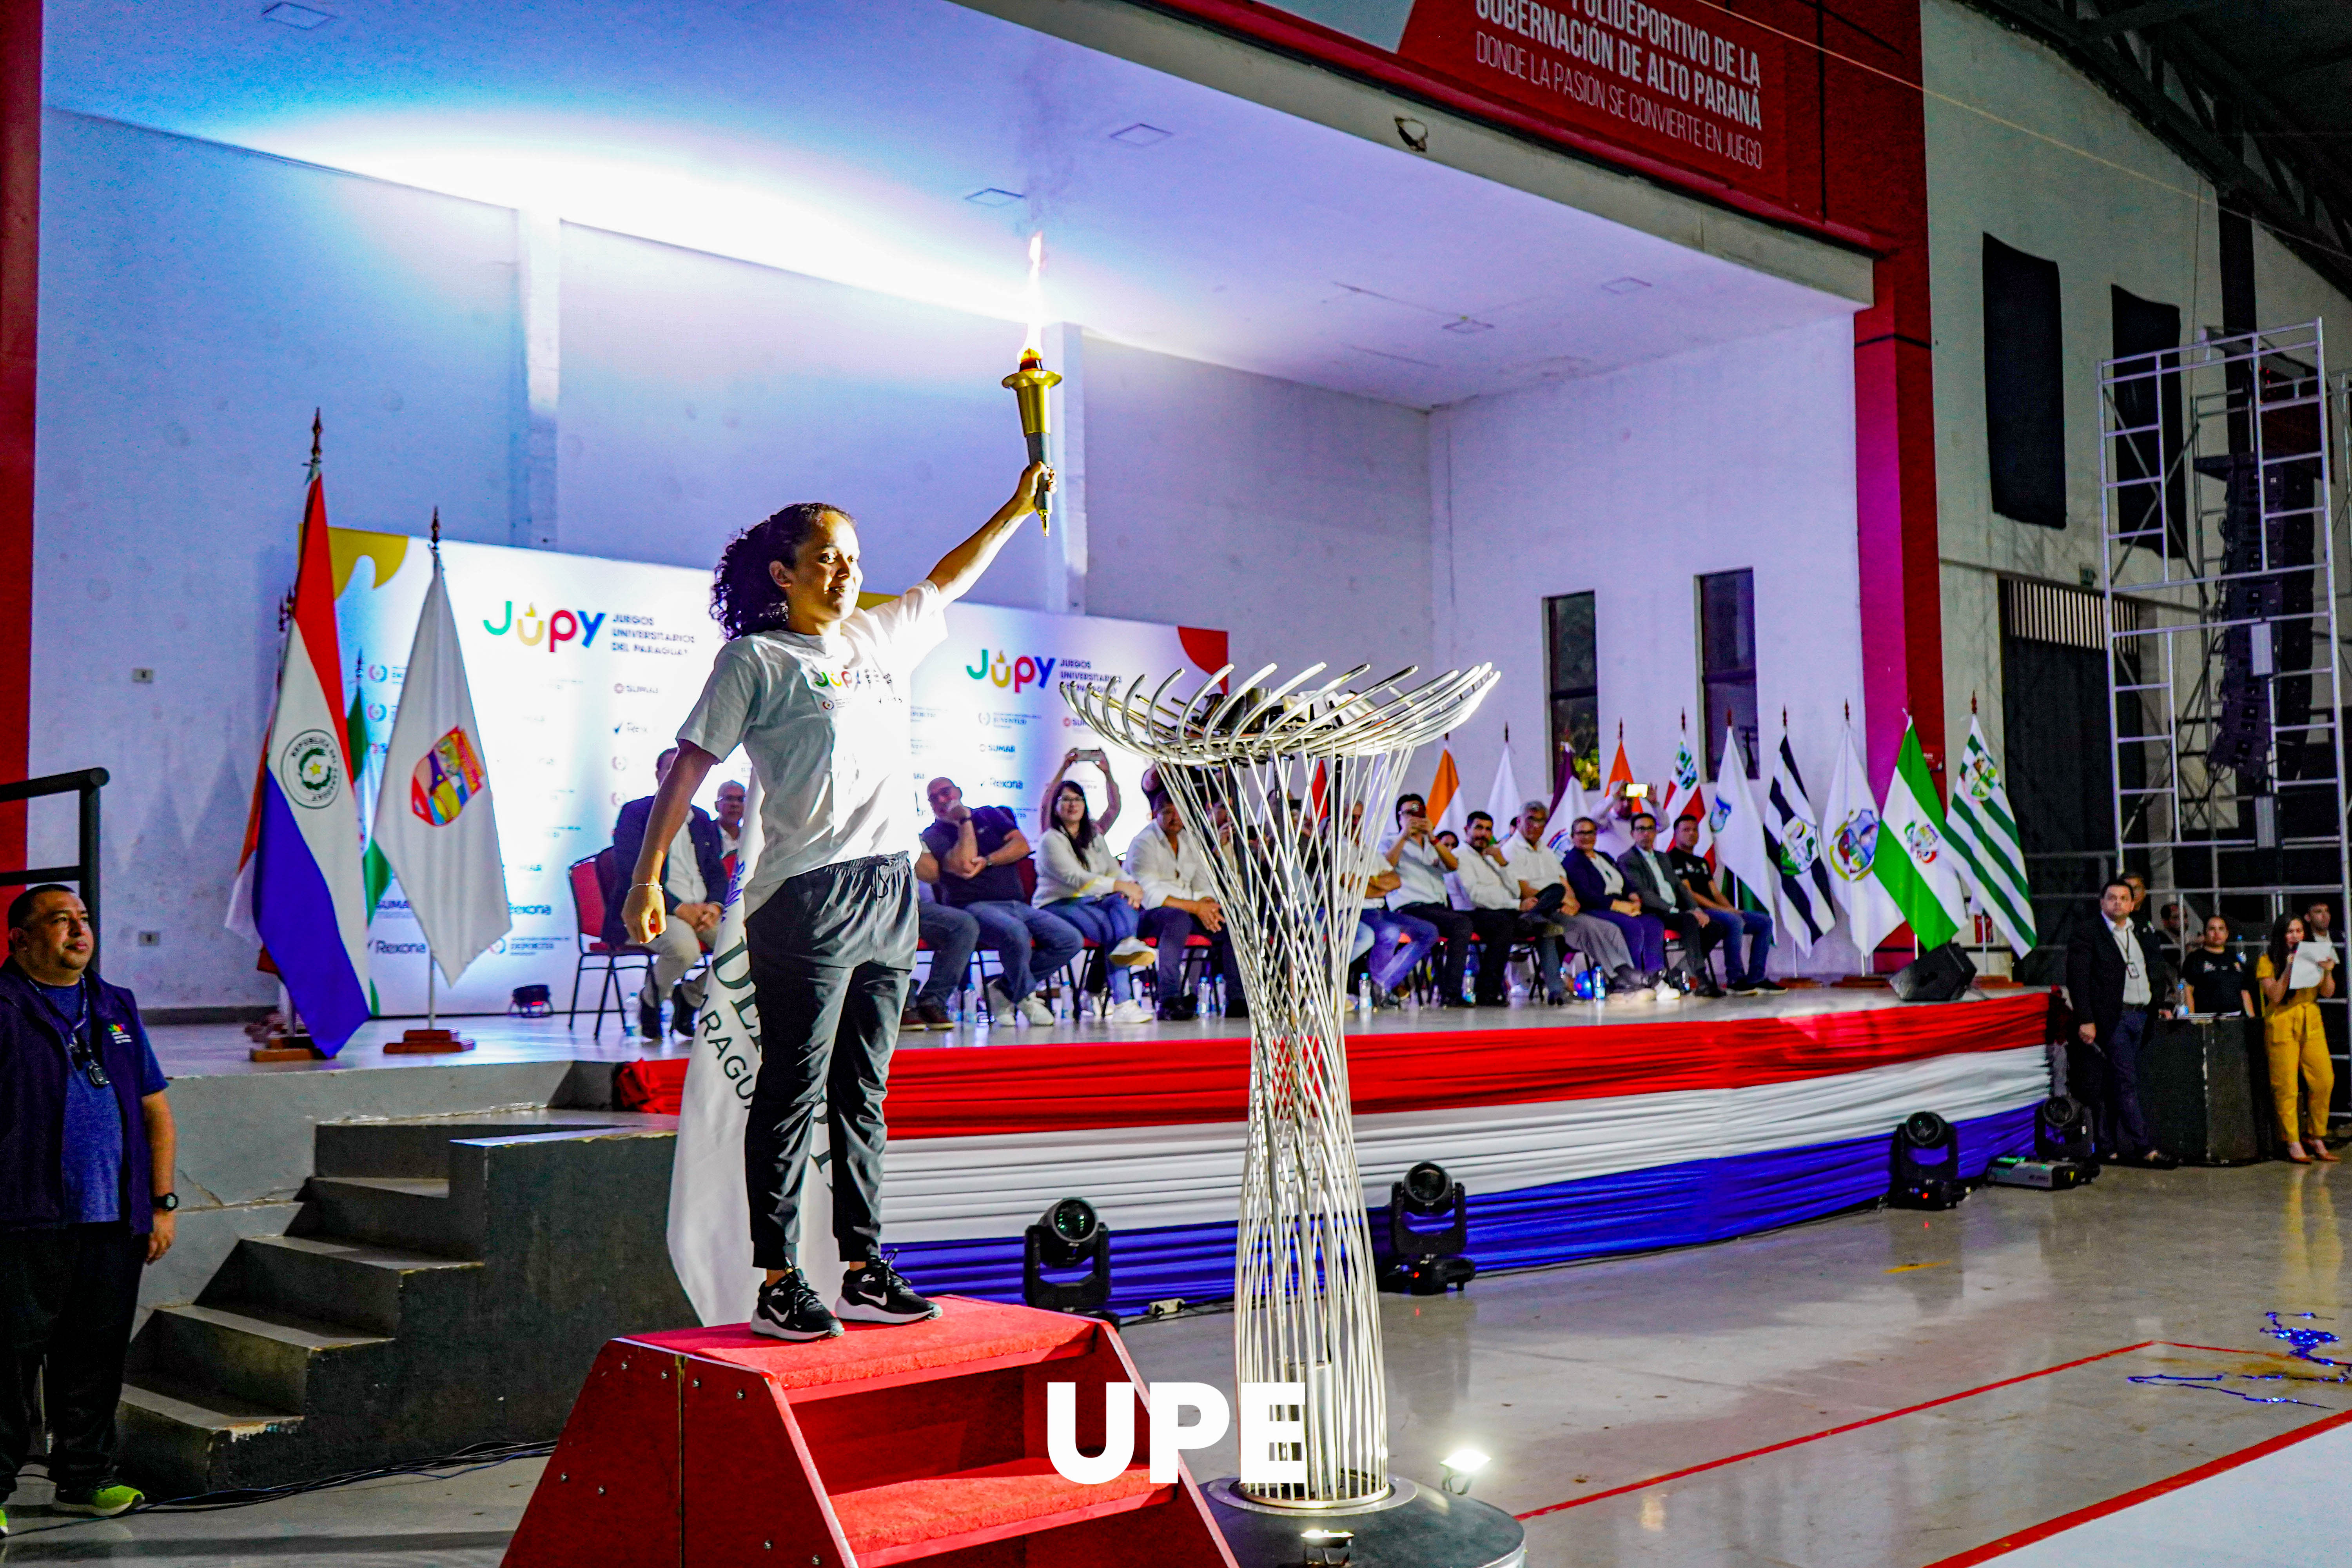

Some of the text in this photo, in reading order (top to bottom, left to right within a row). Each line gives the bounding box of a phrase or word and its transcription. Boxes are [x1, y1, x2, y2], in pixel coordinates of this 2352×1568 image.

[1714, 36, 1736, 78] DE
[1740, 47, 1761, 89] LA
[1619, 39, 1642, 83] DE
[1647, 51, 1690, 101] ALTO
[1694, 70, 1762, 131] PARANÁ
[1476, 31, 1762, 169] DONDE LA PASIÓN SE CONVIERTE EN JUEGO
[612, 613, 654, 626] JUEGOS
[1060, 659, 1092, 669] JUEGOS
[988, 745, 1016, 753] SUMAR
[375, 940, 426, 954] Rexona
